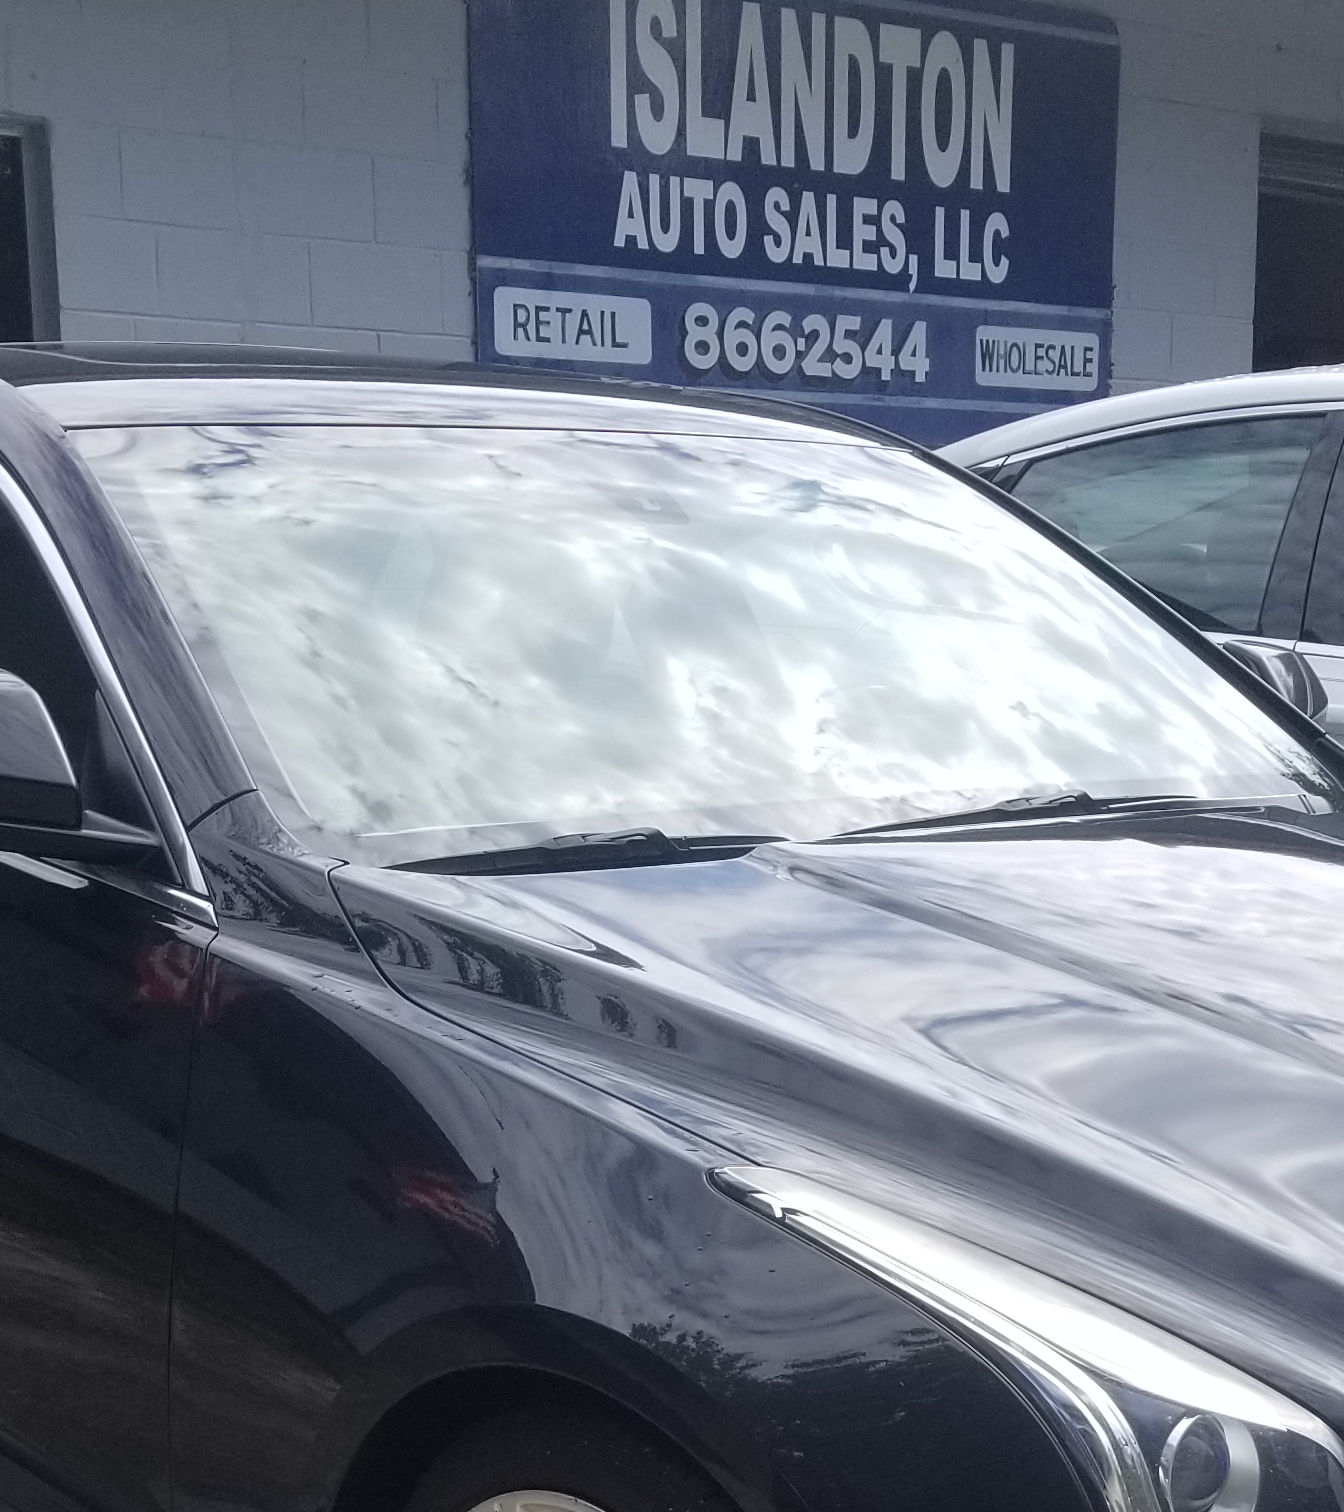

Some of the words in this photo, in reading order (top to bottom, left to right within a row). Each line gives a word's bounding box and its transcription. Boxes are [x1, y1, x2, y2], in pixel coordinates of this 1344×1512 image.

[610, 0, 1015, 193] ISLANDTON
[614, 171, 747, 259] AUTO
[764, 187, 919, 294] SALES,
[935, 206, 1010, 284] LLC
[513, 303, 629, 348] RETAIL
[980, 338, 1094, 378] WHOLESALE
